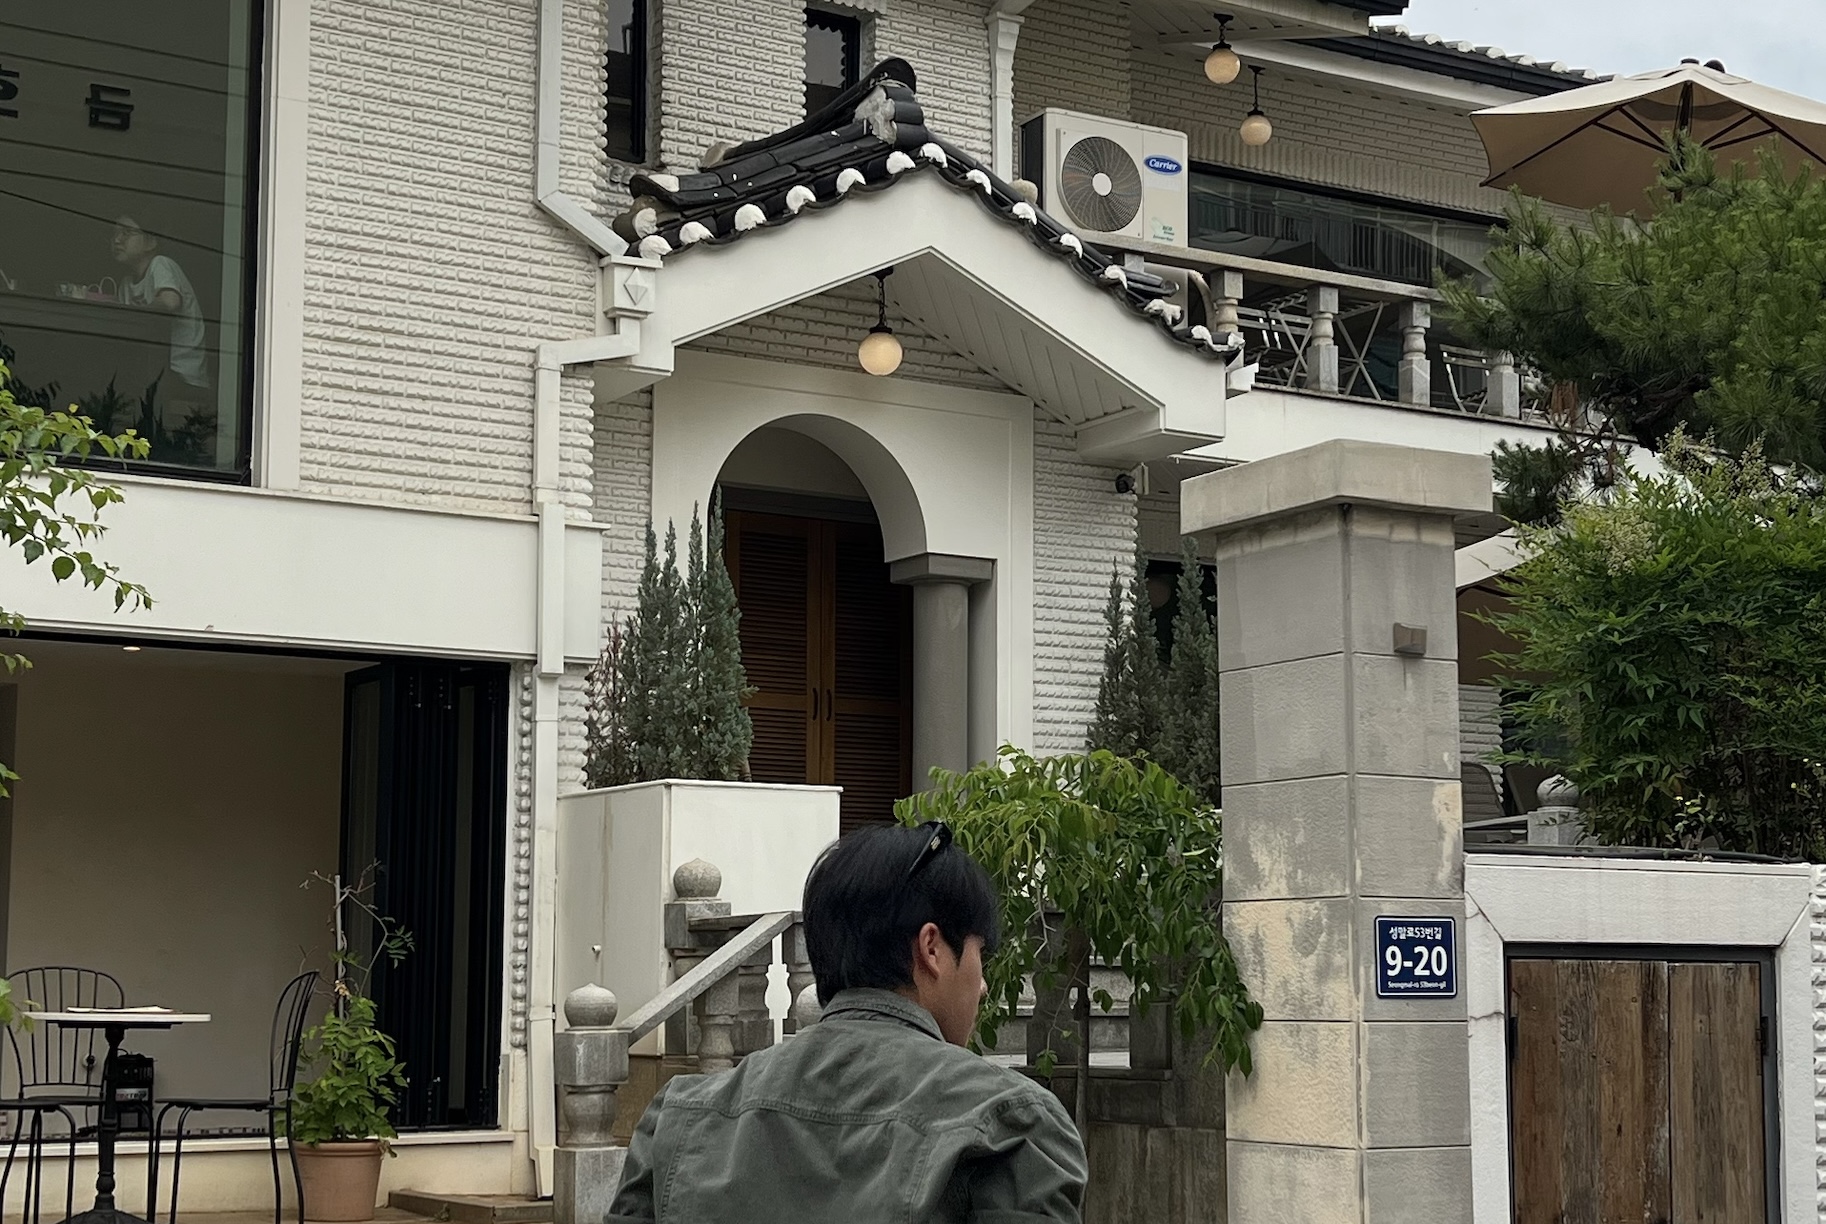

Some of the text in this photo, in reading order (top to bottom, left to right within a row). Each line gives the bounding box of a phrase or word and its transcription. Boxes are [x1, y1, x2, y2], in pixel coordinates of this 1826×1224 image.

[1149, 158, 1178, 171] Carrier
[1389, 926, 1442, 940] 성말로53번길
[1385, 945, 1448, 977] 9-20
